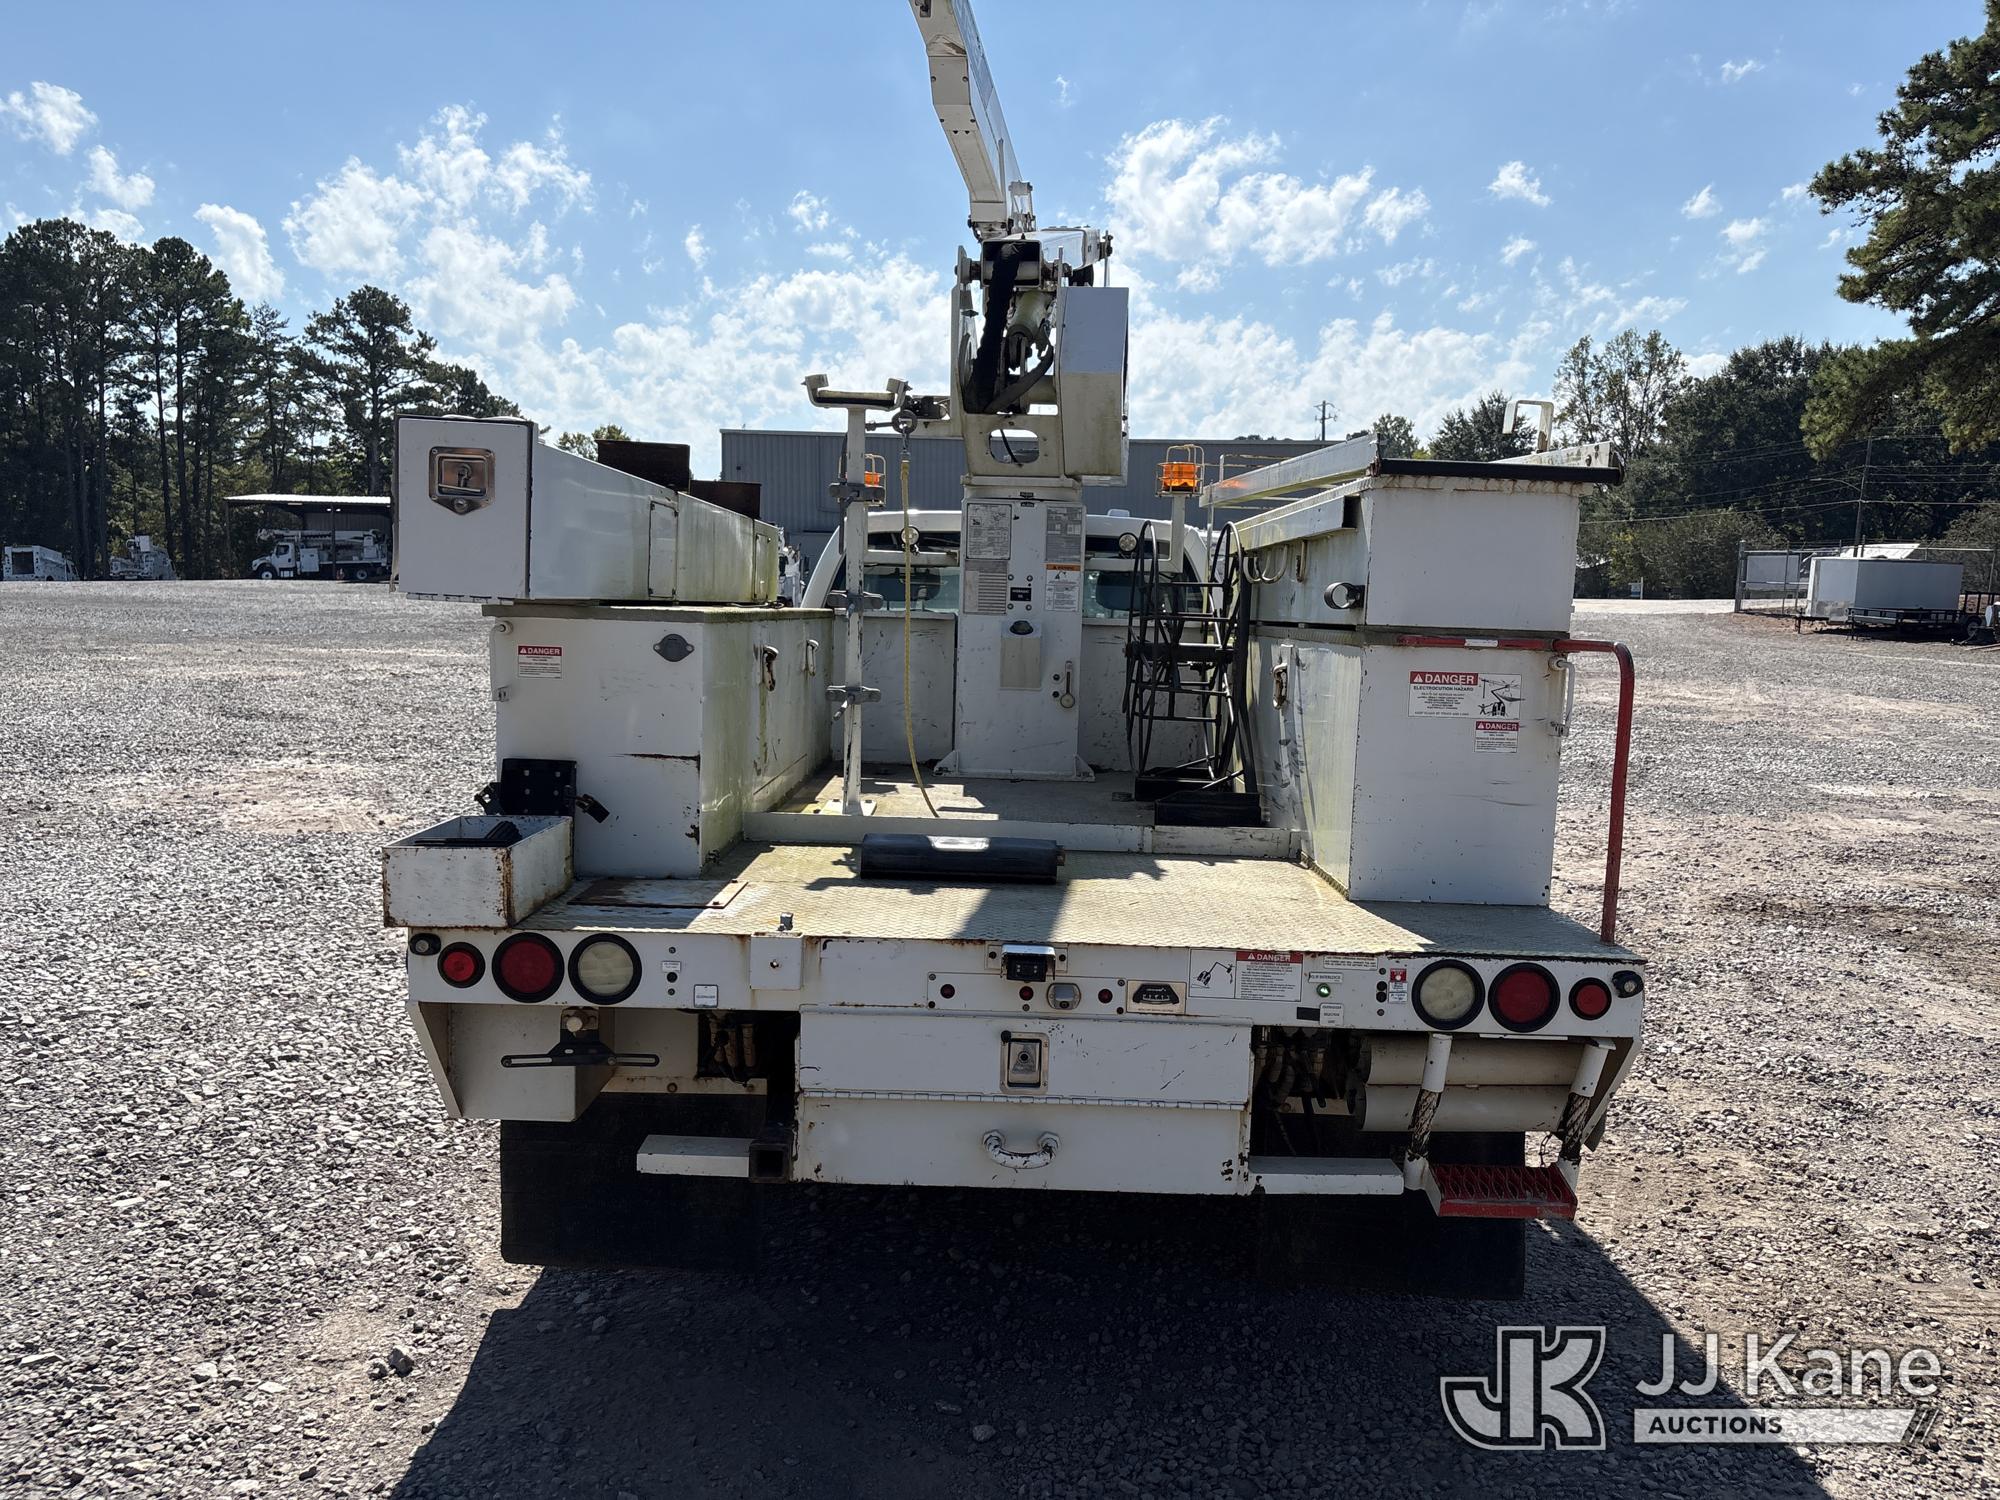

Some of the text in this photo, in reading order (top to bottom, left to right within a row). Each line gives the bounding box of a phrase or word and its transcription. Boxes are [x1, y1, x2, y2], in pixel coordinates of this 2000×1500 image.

[527, 647, 561, 655] DANGER
[1424, 673, 1475, 685] DANGER
[1485, 723, 1518, 731] DANGER
[1256, 953, 1291, 962] DANGER
